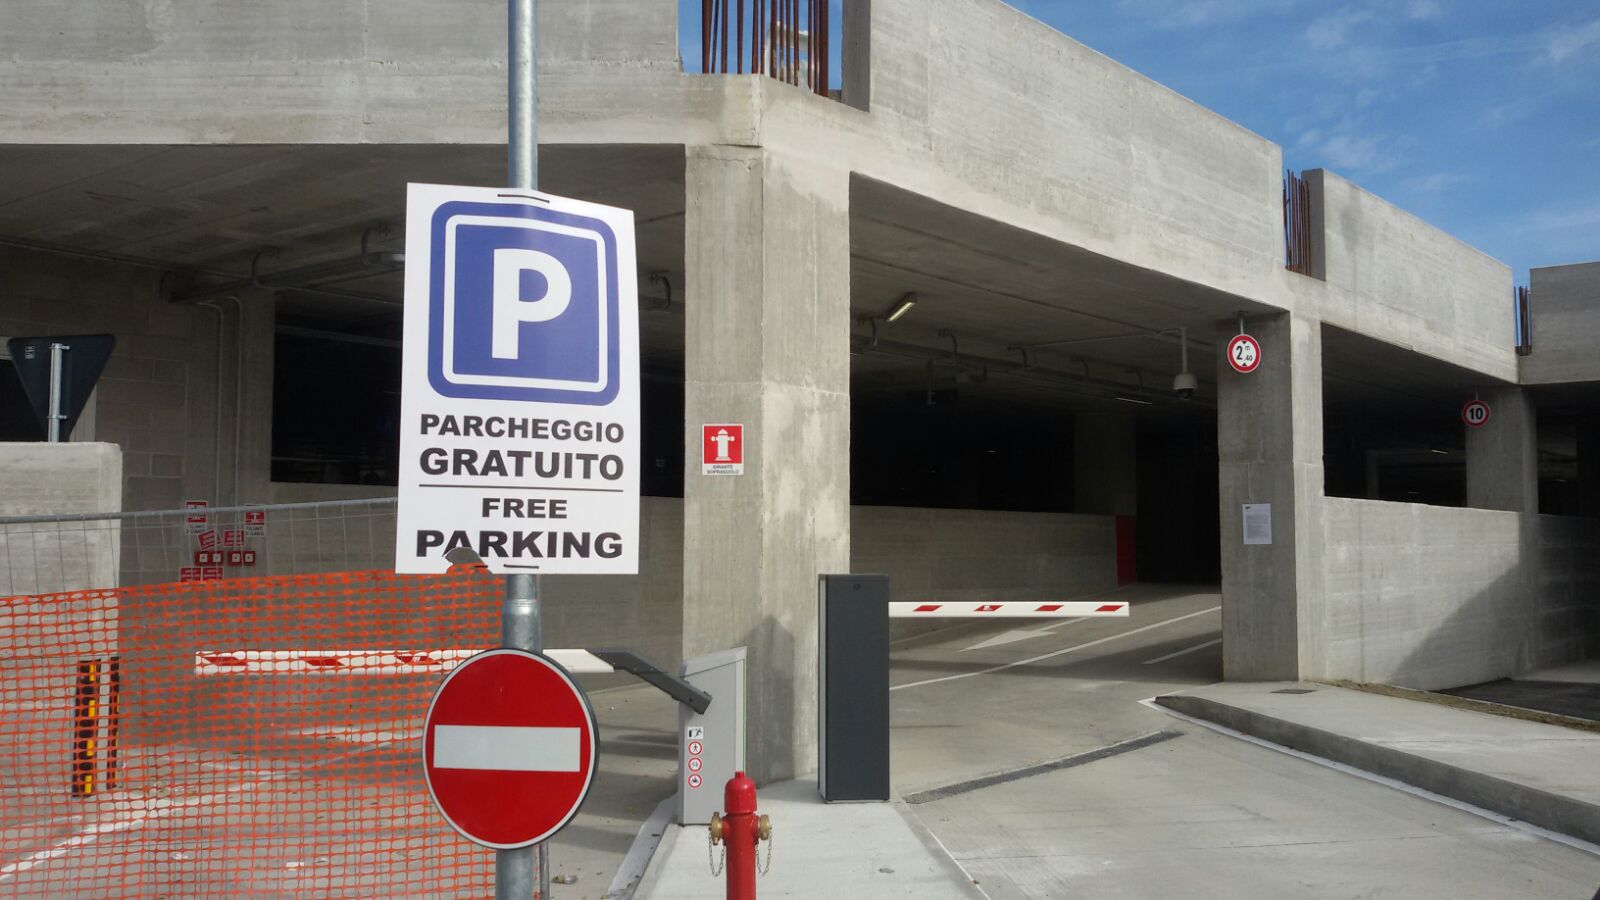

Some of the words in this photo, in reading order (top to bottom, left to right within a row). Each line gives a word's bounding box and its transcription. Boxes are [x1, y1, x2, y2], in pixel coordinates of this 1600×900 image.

[492, 248, 572, 360] P
[1236, 345, 1243, 360] 2
[420, 413, 625, 443] PARCHEGGIO
[1469, 407, 1484, 420] 10
[419, 447, 624, 481] GRATUITO
[482, 497, 568, 519] FREE
[416, 530, 623, 559] PARKING
